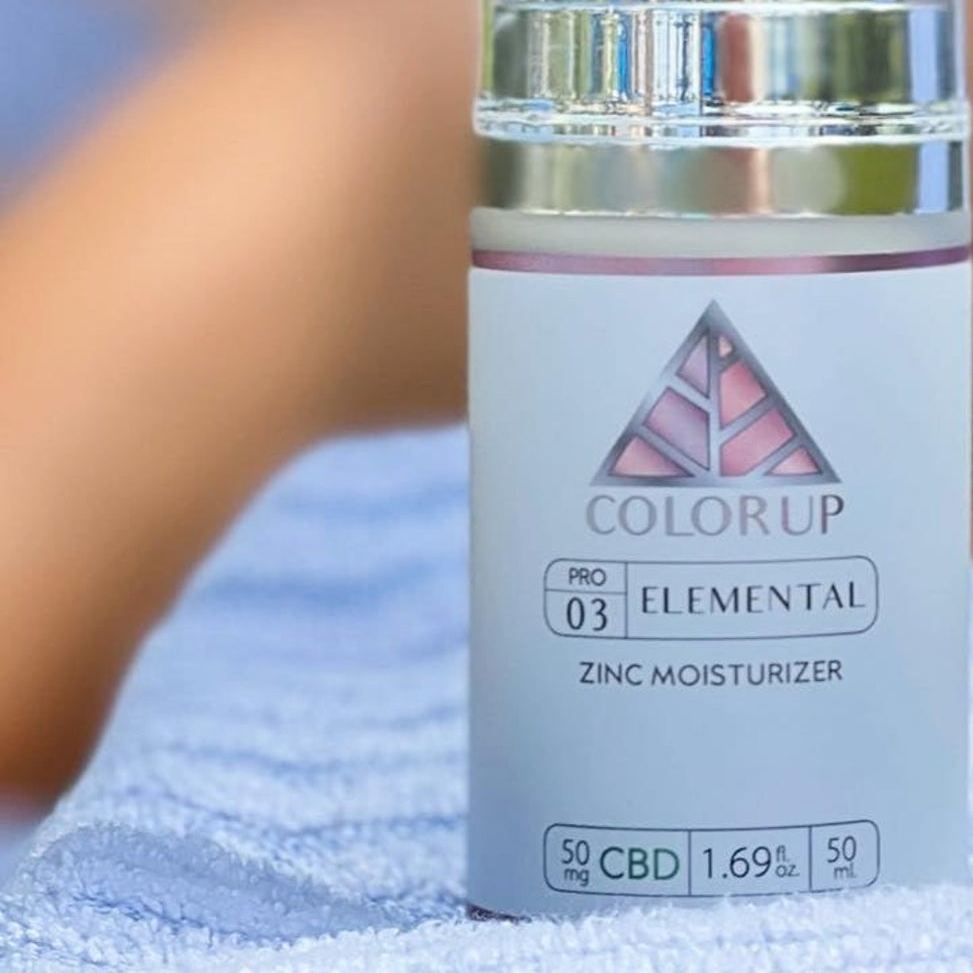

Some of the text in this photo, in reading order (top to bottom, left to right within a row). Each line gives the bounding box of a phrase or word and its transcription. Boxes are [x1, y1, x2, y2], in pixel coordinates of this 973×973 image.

[567, 567, 607, 587] PRO
[640, 581, 866, 615] ELEMENTAL
[566, 596, 608, 632] 03
[579, 658, 843, 687] ZINC MOISTURIZER
[561, 838, 590, 865] 50
[599, 846, 680, 880] CBD
[702, 845, 772, 879] 1.69
[826, 835, 857, 863] 50
[563, 868, 589, 887] mg
